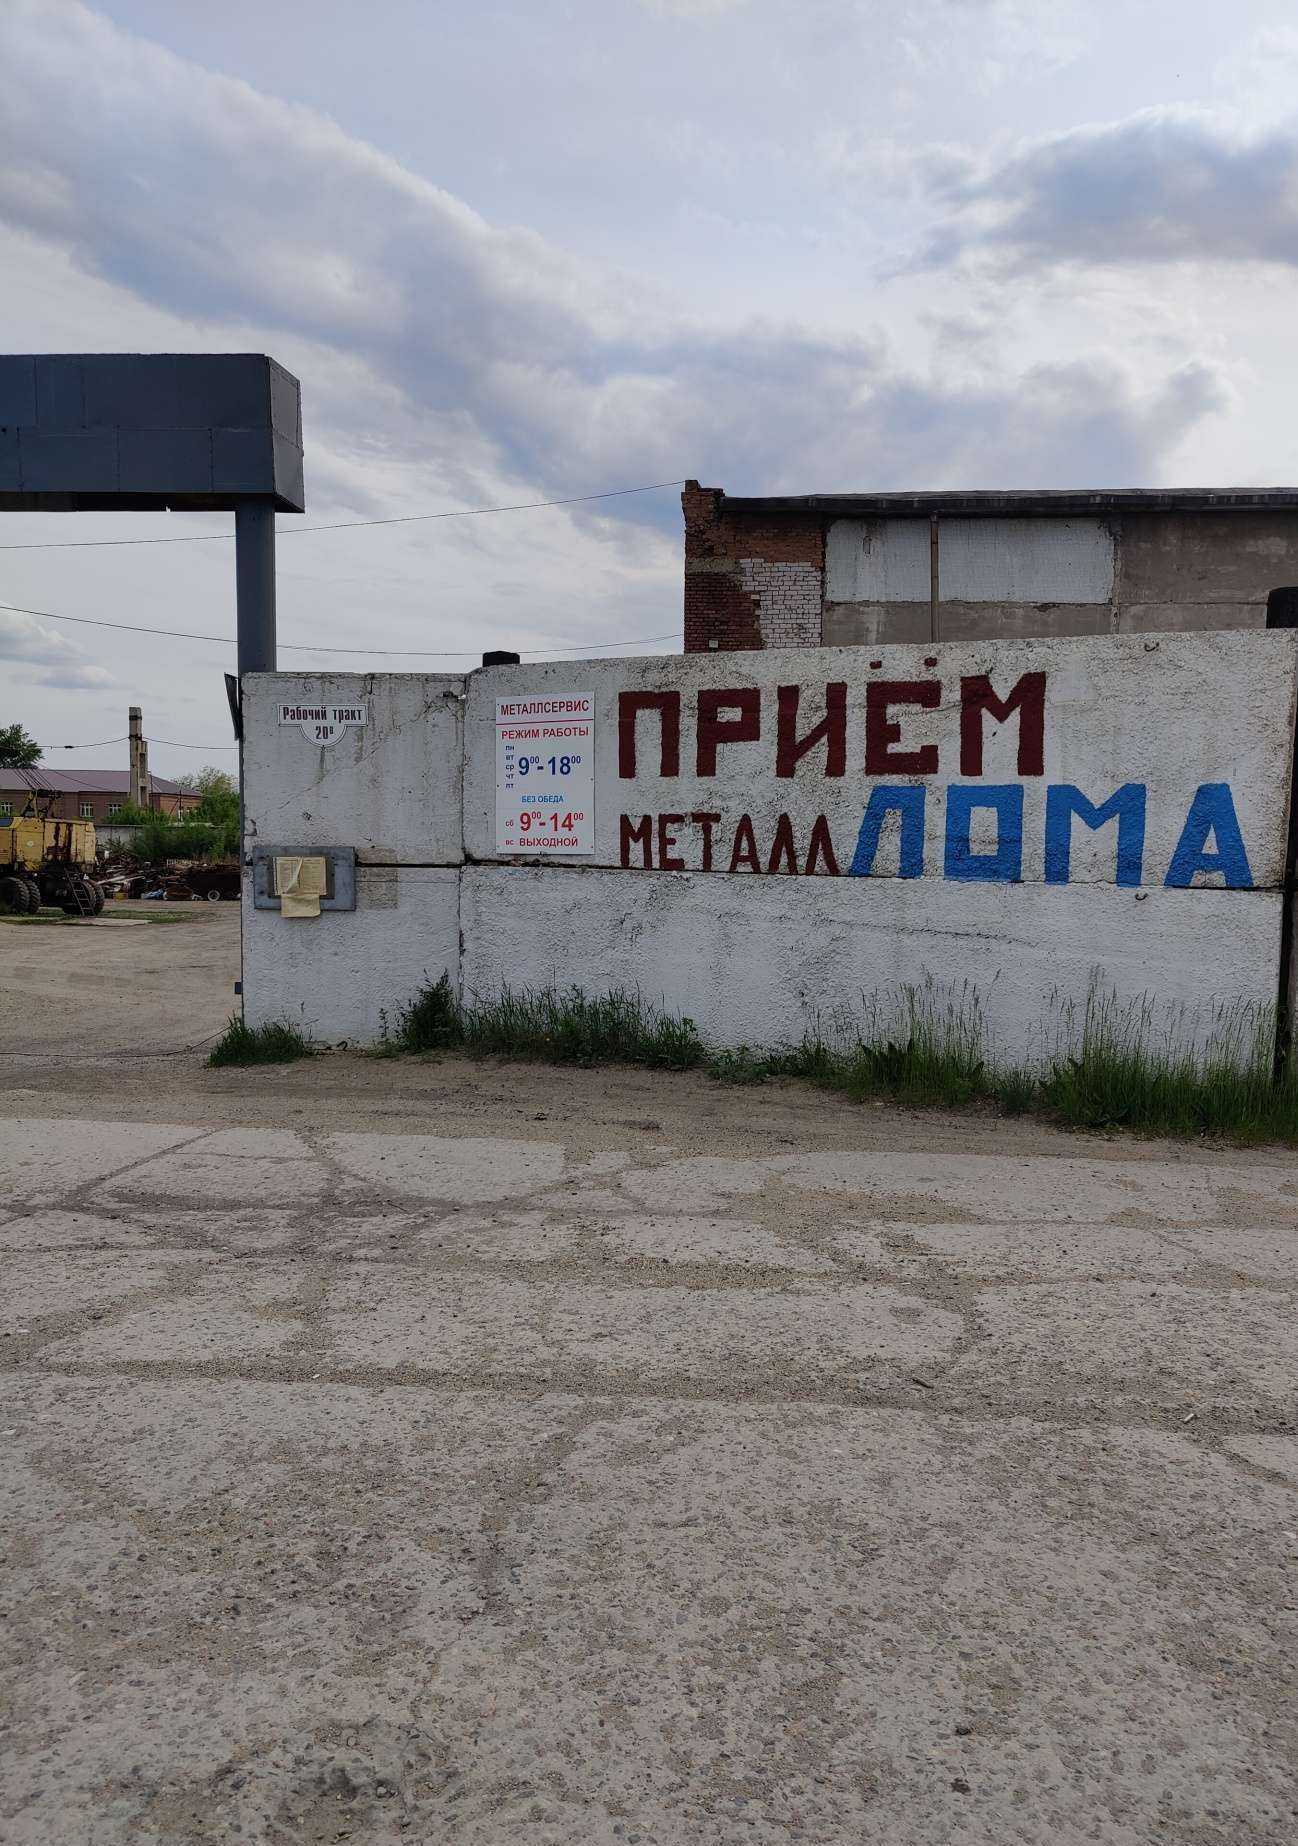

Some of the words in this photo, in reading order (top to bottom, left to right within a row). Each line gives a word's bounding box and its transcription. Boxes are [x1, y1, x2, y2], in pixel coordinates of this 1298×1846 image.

[501, 700, 589, 716] МЕТАЛЛСЕРВИС
[283, 707, 327, 720] Рабочий
[333, 710, 363, 723] тракт
[502, 730, 540, 740] РЕЖИМ
[543, 727, 589, 738] РАБОТЫ
[537, 795, 564, 804] ОБЕДА
[519, 837, 578, 848] ВЫХОДНОЙ
